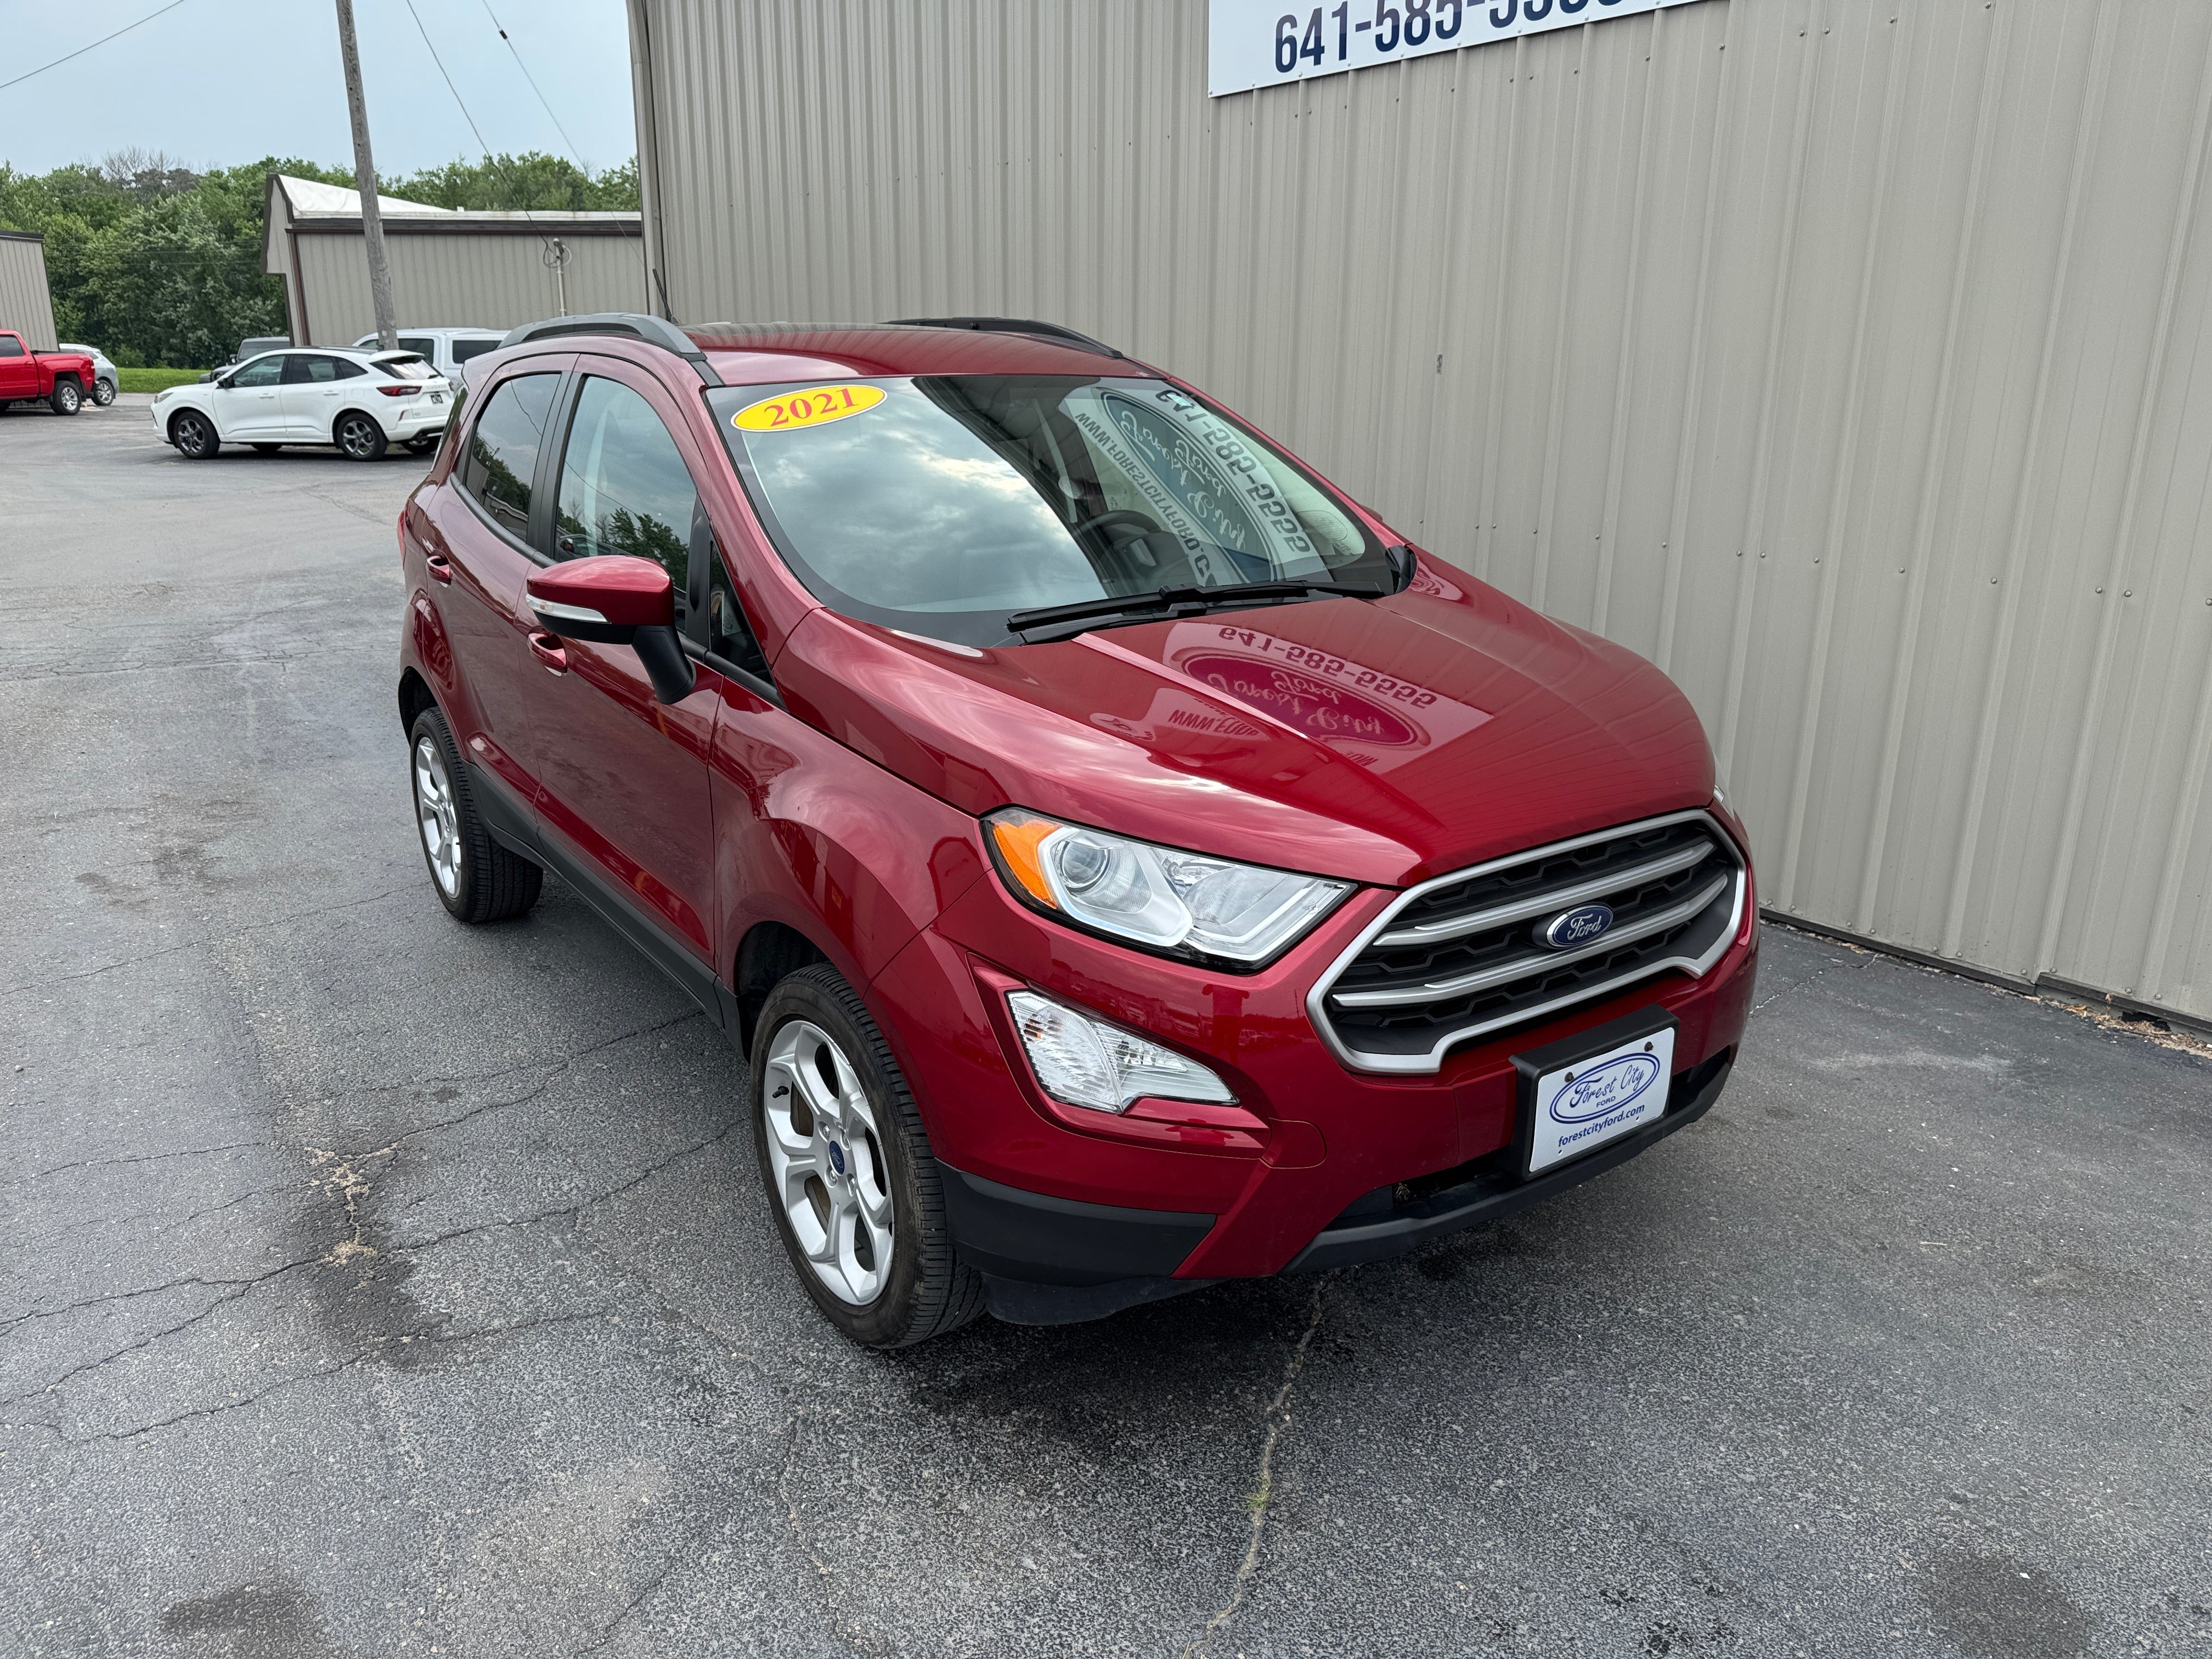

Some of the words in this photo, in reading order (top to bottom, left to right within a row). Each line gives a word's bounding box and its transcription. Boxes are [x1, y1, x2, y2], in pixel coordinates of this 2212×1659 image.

[764, 387, 859, 427] 2021
[1566, 913, 1602, 941] Ford
[1569, 1075, 1616, 1108] Forest
[1620, 1064, 1645, 1092] City
[1596, 1096, 1616, 1108] FORD
[1558, 1103, 1645, 1148] forestcityford.com
